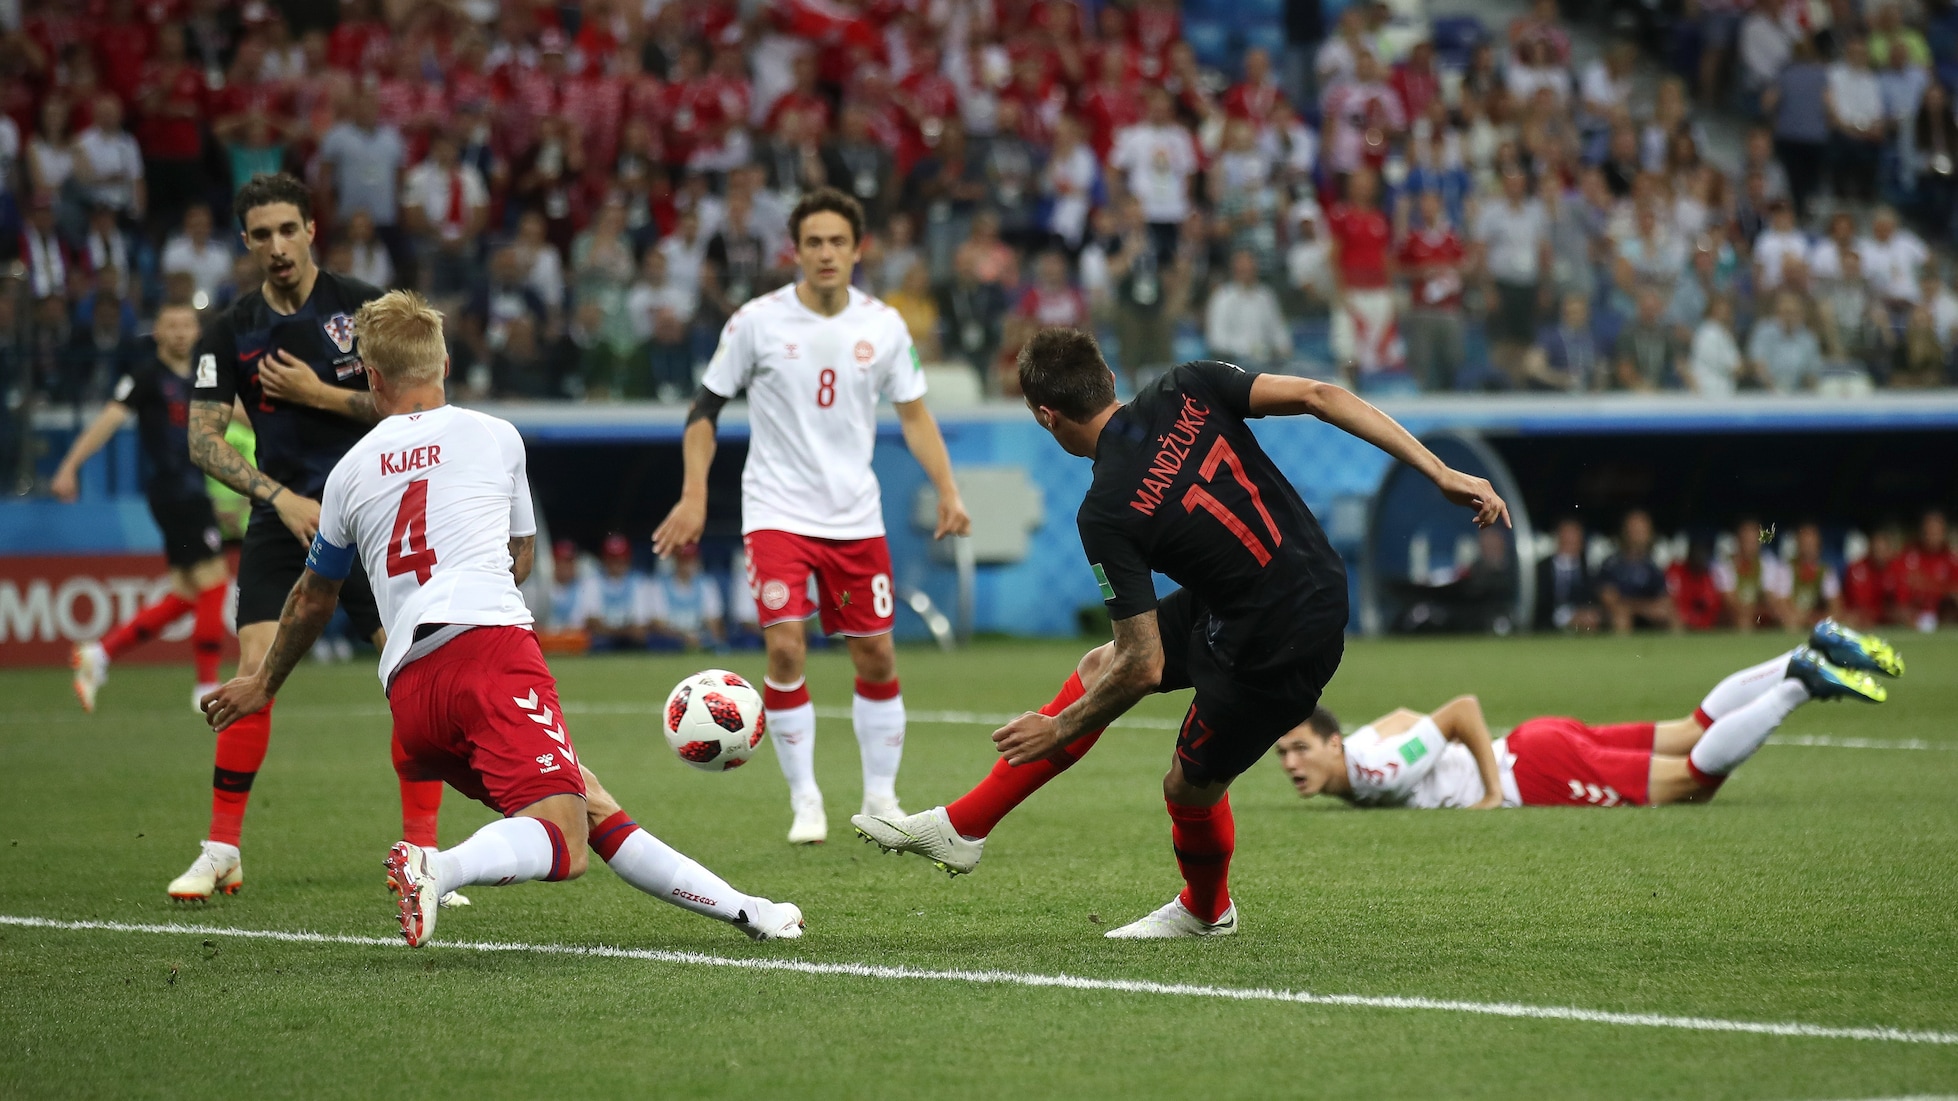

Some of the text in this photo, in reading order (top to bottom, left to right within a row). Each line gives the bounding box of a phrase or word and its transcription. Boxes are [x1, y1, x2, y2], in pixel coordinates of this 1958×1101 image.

[818, 368, 836, 408] 8
[381, 445, 441, 476] KJÆR
[1129, 393, 1211, 517] MANDŽUKIĆ
[386, 479, 438, 587] 4
[1181, 434, 1282, 568] 17
[871, 573, 894, 618] 8
